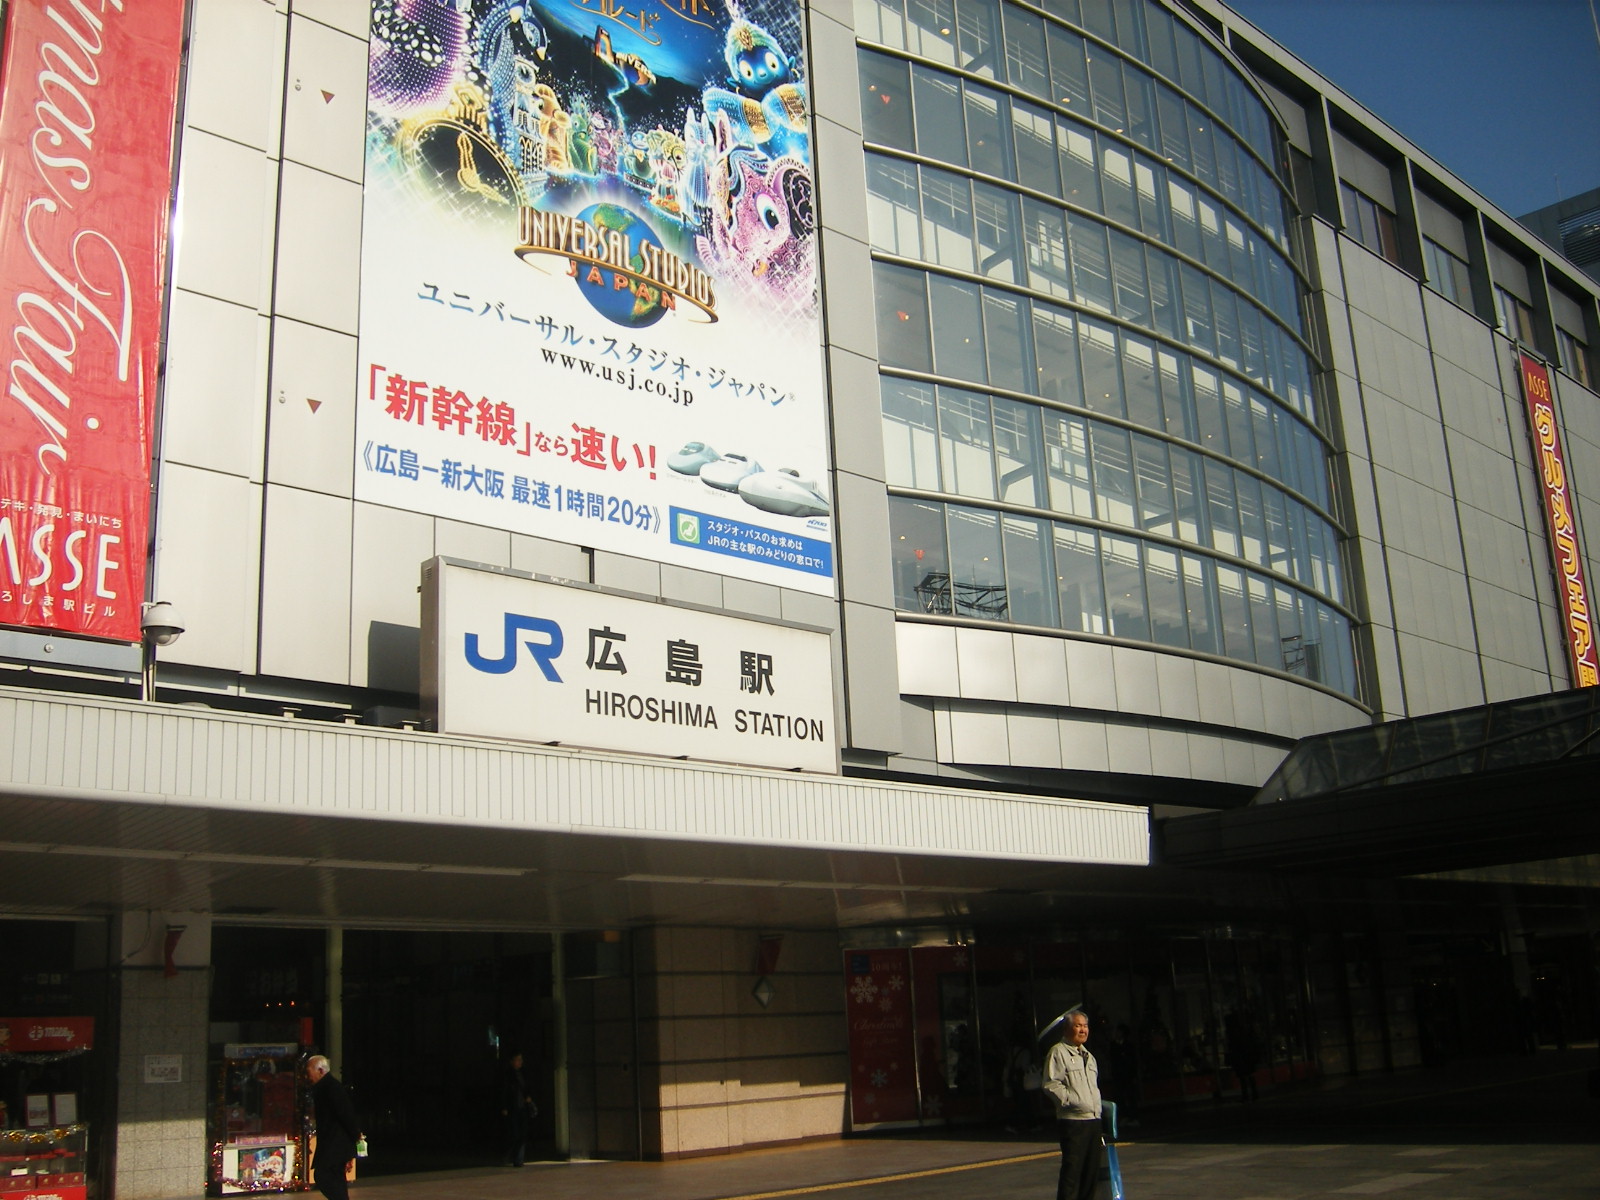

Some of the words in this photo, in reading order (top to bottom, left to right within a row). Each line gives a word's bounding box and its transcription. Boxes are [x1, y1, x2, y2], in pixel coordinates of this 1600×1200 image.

[32, 0, 123, 209] mas
[518, 206, 635, 272] UNIVERSAL
[640, 238, 719, 311] STUDIOS
[565, 260, 676, 311] JAPAN
[8, 197, 130, 476] Fair
[541, 347, 694, 406] www.usj.co.jp
[1527, 371, 1549, 401] ASSE
[464, 612, 564, 684] JR
[585, 625, 775, 697] 広島駅
[585, 688, 719, 730] HIROSHIMA
[734, 709, 825, 742] STATION
